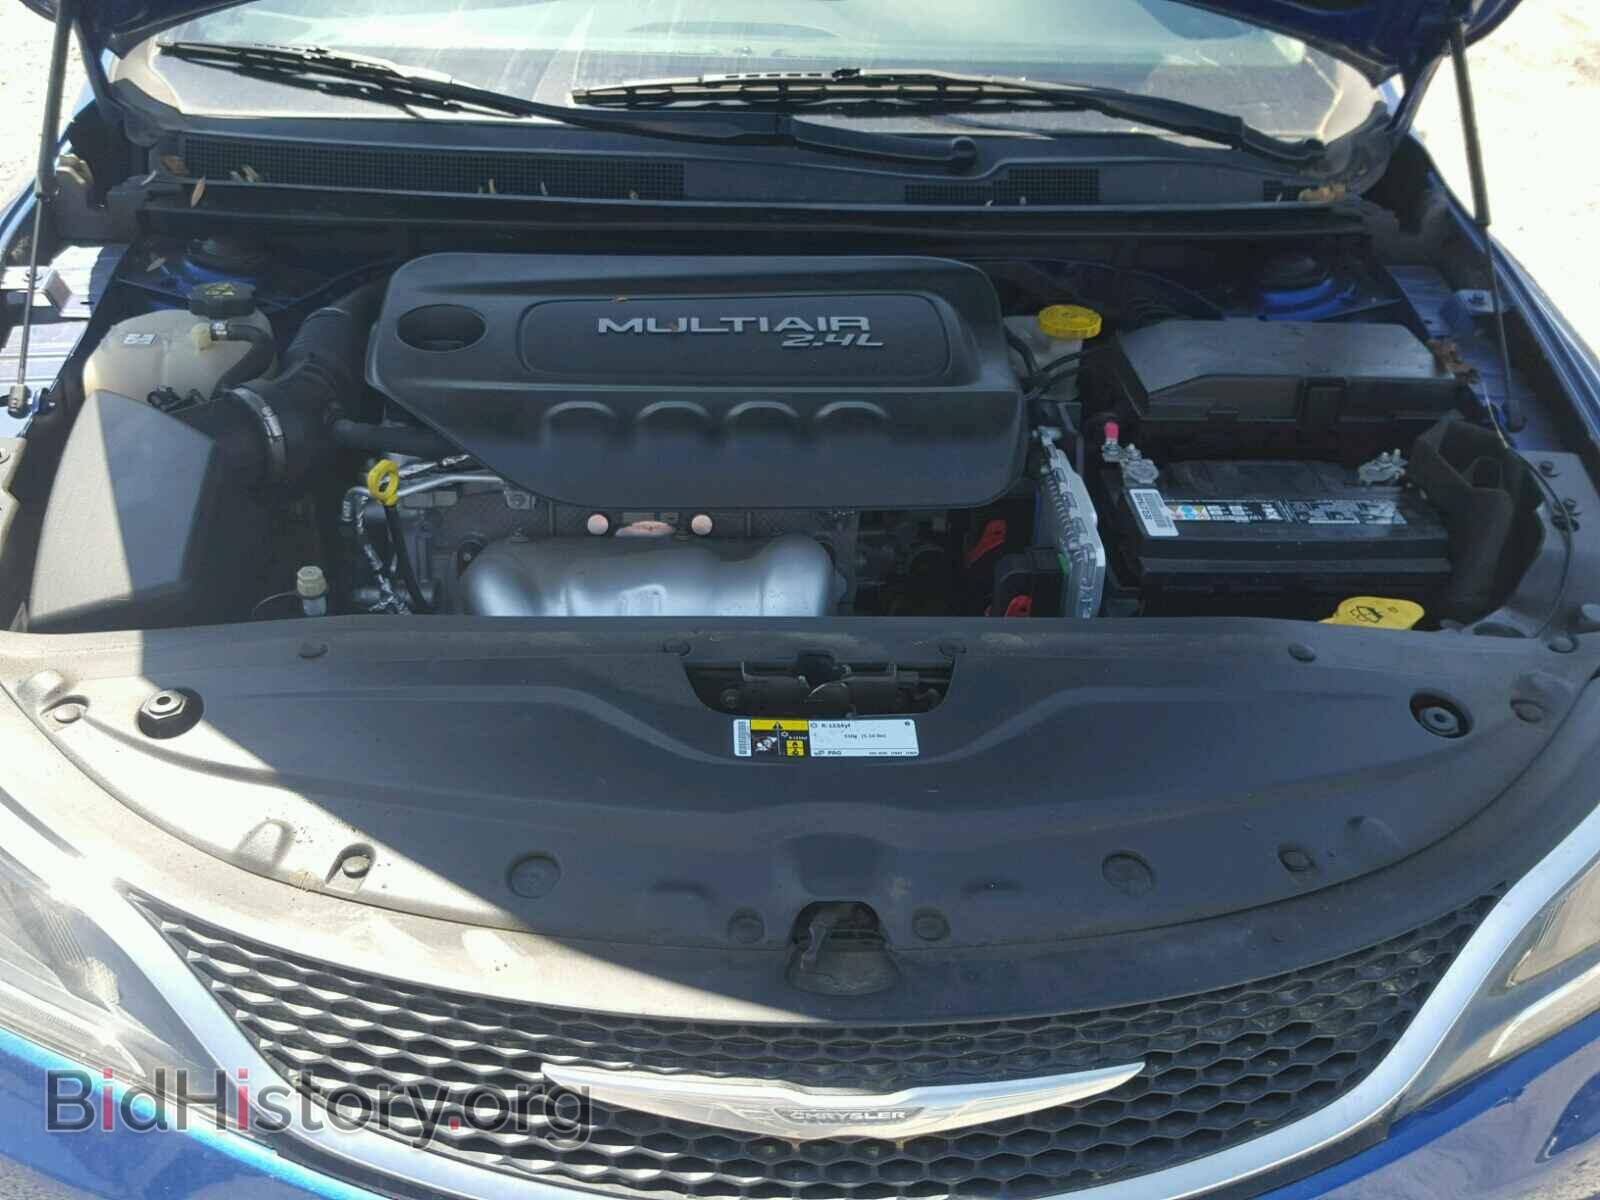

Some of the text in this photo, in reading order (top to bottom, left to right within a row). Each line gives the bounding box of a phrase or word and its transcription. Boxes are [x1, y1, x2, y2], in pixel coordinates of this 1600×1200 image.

[597, 316, 871, 333] MULTIAIR
[781, 333, 885, 347] 2.4L
[791, 1110, 906, 1121] CHRYSLER
